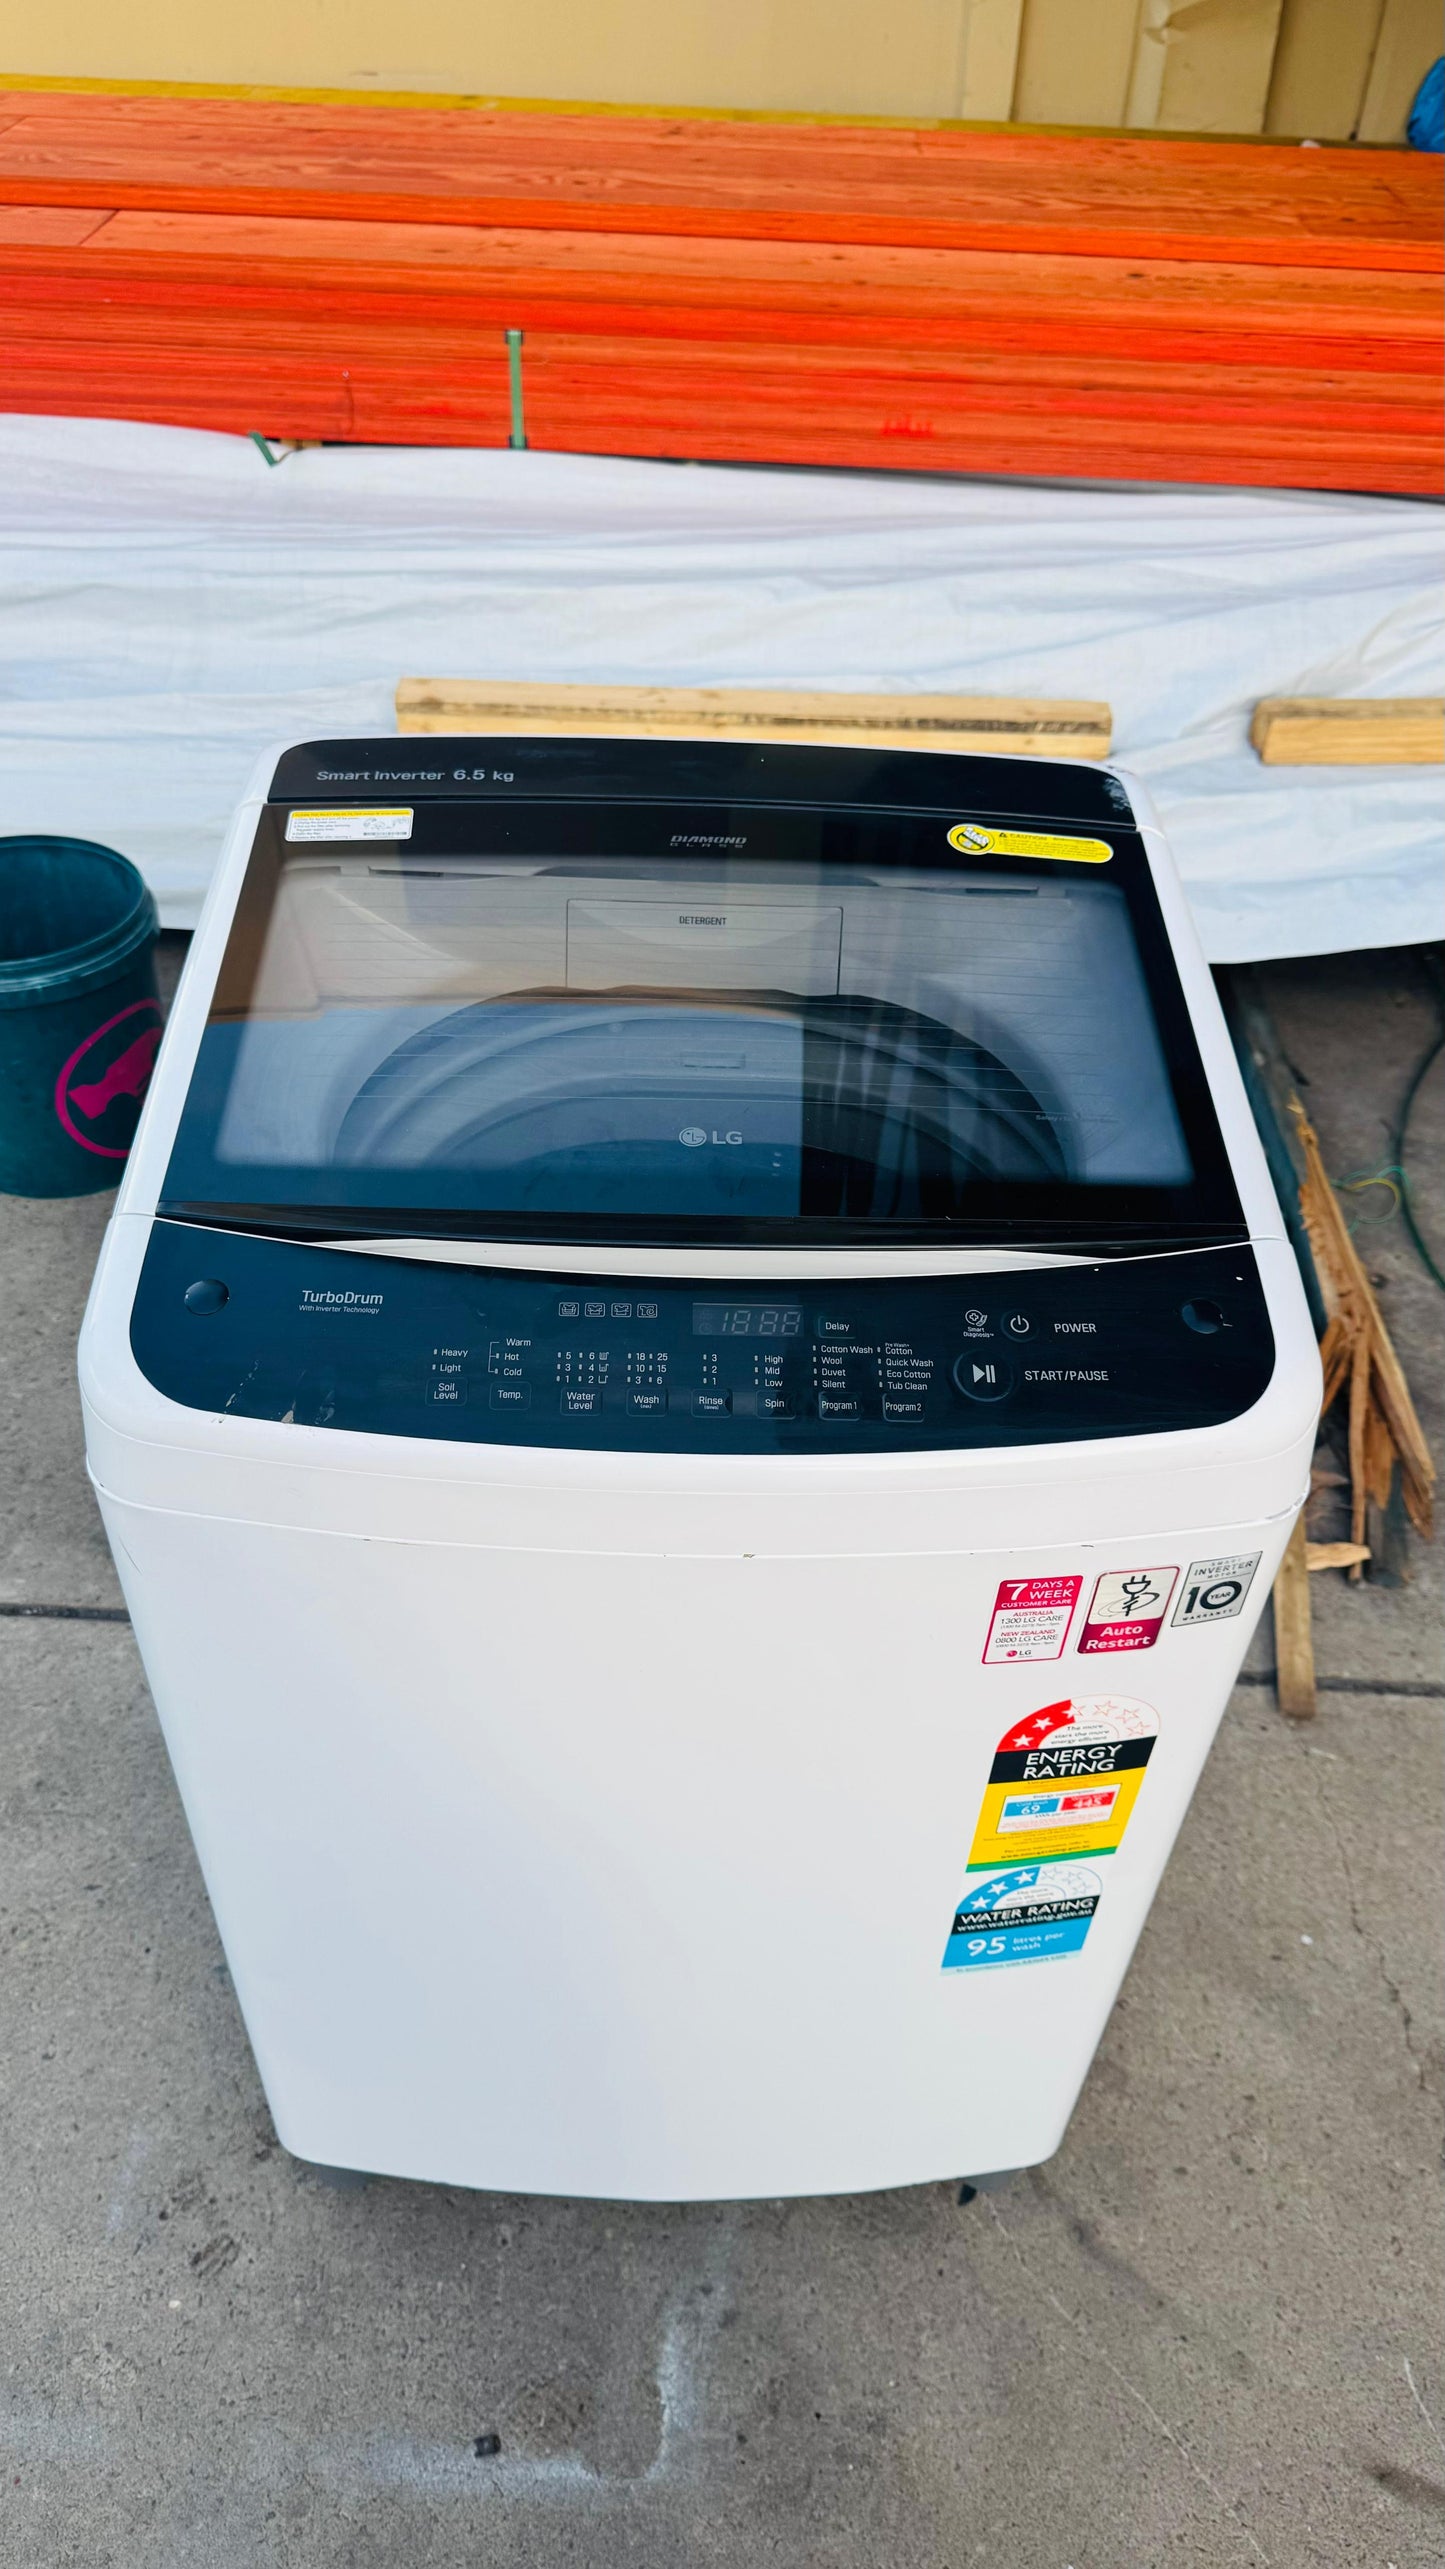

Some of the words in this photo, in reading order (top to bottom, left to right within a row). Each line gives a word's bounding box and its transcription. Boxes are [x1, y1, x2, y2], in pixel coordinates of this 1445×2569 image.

[317, 771, 370, 780] Smart
[374, 771, 445, 780] Inverter
[453, 769, 486, 781] 6.5
[493, 770, 514, 782] kg
[670, 835, 747, 844] DIAMOND
[679, 915, 727, 925] DETERGENT
[712, 1131, 743, 1145] LG
[302, 1290, 383, 1304] TurboDrum
[315, 1305, 341, 1313] Inverter
[343, 1306, 379, 1315] Technology
[825, 1322, 850, 1332] Delay
[1054, 1323, 1097, 1333] POWER
[506, 1338, 531, 1346] Warm
[441, 1349, 468, 1357] Heavy
[821, 1345, 848, 1353] Cotton
[850, 1346, 873, 1354] Wash
[885, 1347, 912, 1355] Cotton
[566, 1352, 571, 1360] 5
[589, 1352, 595, 1360] 6
[636, 1353, 646, 1361] 18
[657, 1353, 667, 1361] 25
[712, 1354, 717, 1362] 3
[764, 1355, 783, 1364] High
[885, 1358, 908, 1367] Quick
[910, 1359, 934, 1367] Wash
[440, 1364, 461, 1373] Light
[503, 1368, 522, 1376] Cold
[565, 1364, 571, 1372] 3
[588, 1364, 594, 1372] 4
[636, 1365, 645, 1373] 10
[657, 1365, 667, 1373] 15
[712, 1366, 717, 1374] 2
[765, 1367, 780, 1375] Mid
[821, 1368, 846, 1376] Duvet
[886, 1370, 901, 1378] Eco
[903, 1371, 931, 1379] Cotton
[1024, 1370, 1109, 1381] START/PAUSE
[588, 1376, 594, 1384] 2
[635, 1376, 642, 1384] 3
[656, 1376, 663, 1385] 6
[765, 1379, 783, 1387] Low
[822, 1380, 846, 1389] Silent
[438, 1383, 455, 1391] Soil
[888, 1381, 903, 1390] Tub
[904, 1382, 928, 1390] Clean
[433, 1391, 458, 1399] Level
[498, 1390, 523, 1400] Temp.
[567, 1392, 595, 1400] Water
[633, 1395, 660, 1404] Wash
[699, 1396, 723, 1405] Rinse
[765, 1399, 785, 1409] Spin
[568, 1401, 593, 1410] Level
[821, 1400, 852, 1411] Program
[885, 1402, 916, 1413] Program
[916, 1403, 922, 1411] 2
[1194, 1560, 1253, 1576] INVERTER
[1006, 1583, 1028, 1601] 7
[1032, 1580, 1063, 1589] DAYS
[1029, 1589, 1074, 1600] WEEK
[1185, 1580, 1242, 1614] 10
[1210, 1591, 1232, 1600] YEAR
[1001, 1600, 1048, 1608] CUSTOMER
[1001, 1617, 1022, 1625] 1300
[1100, 1626, 1143, 1637] Auto
[1086, 1636, 1150, 1650] Restart
[1026, 1744, 1122, 1765] ENERGY
[1023, 1759, 1115, 1779] RATING
[1021, 1804, 1041, 1815] 69
[961, 1908, 1021, 1925] WATER
[1028, 1898, 1094, 1916] RATING
[967, 1936, 1006, 1957] 95
